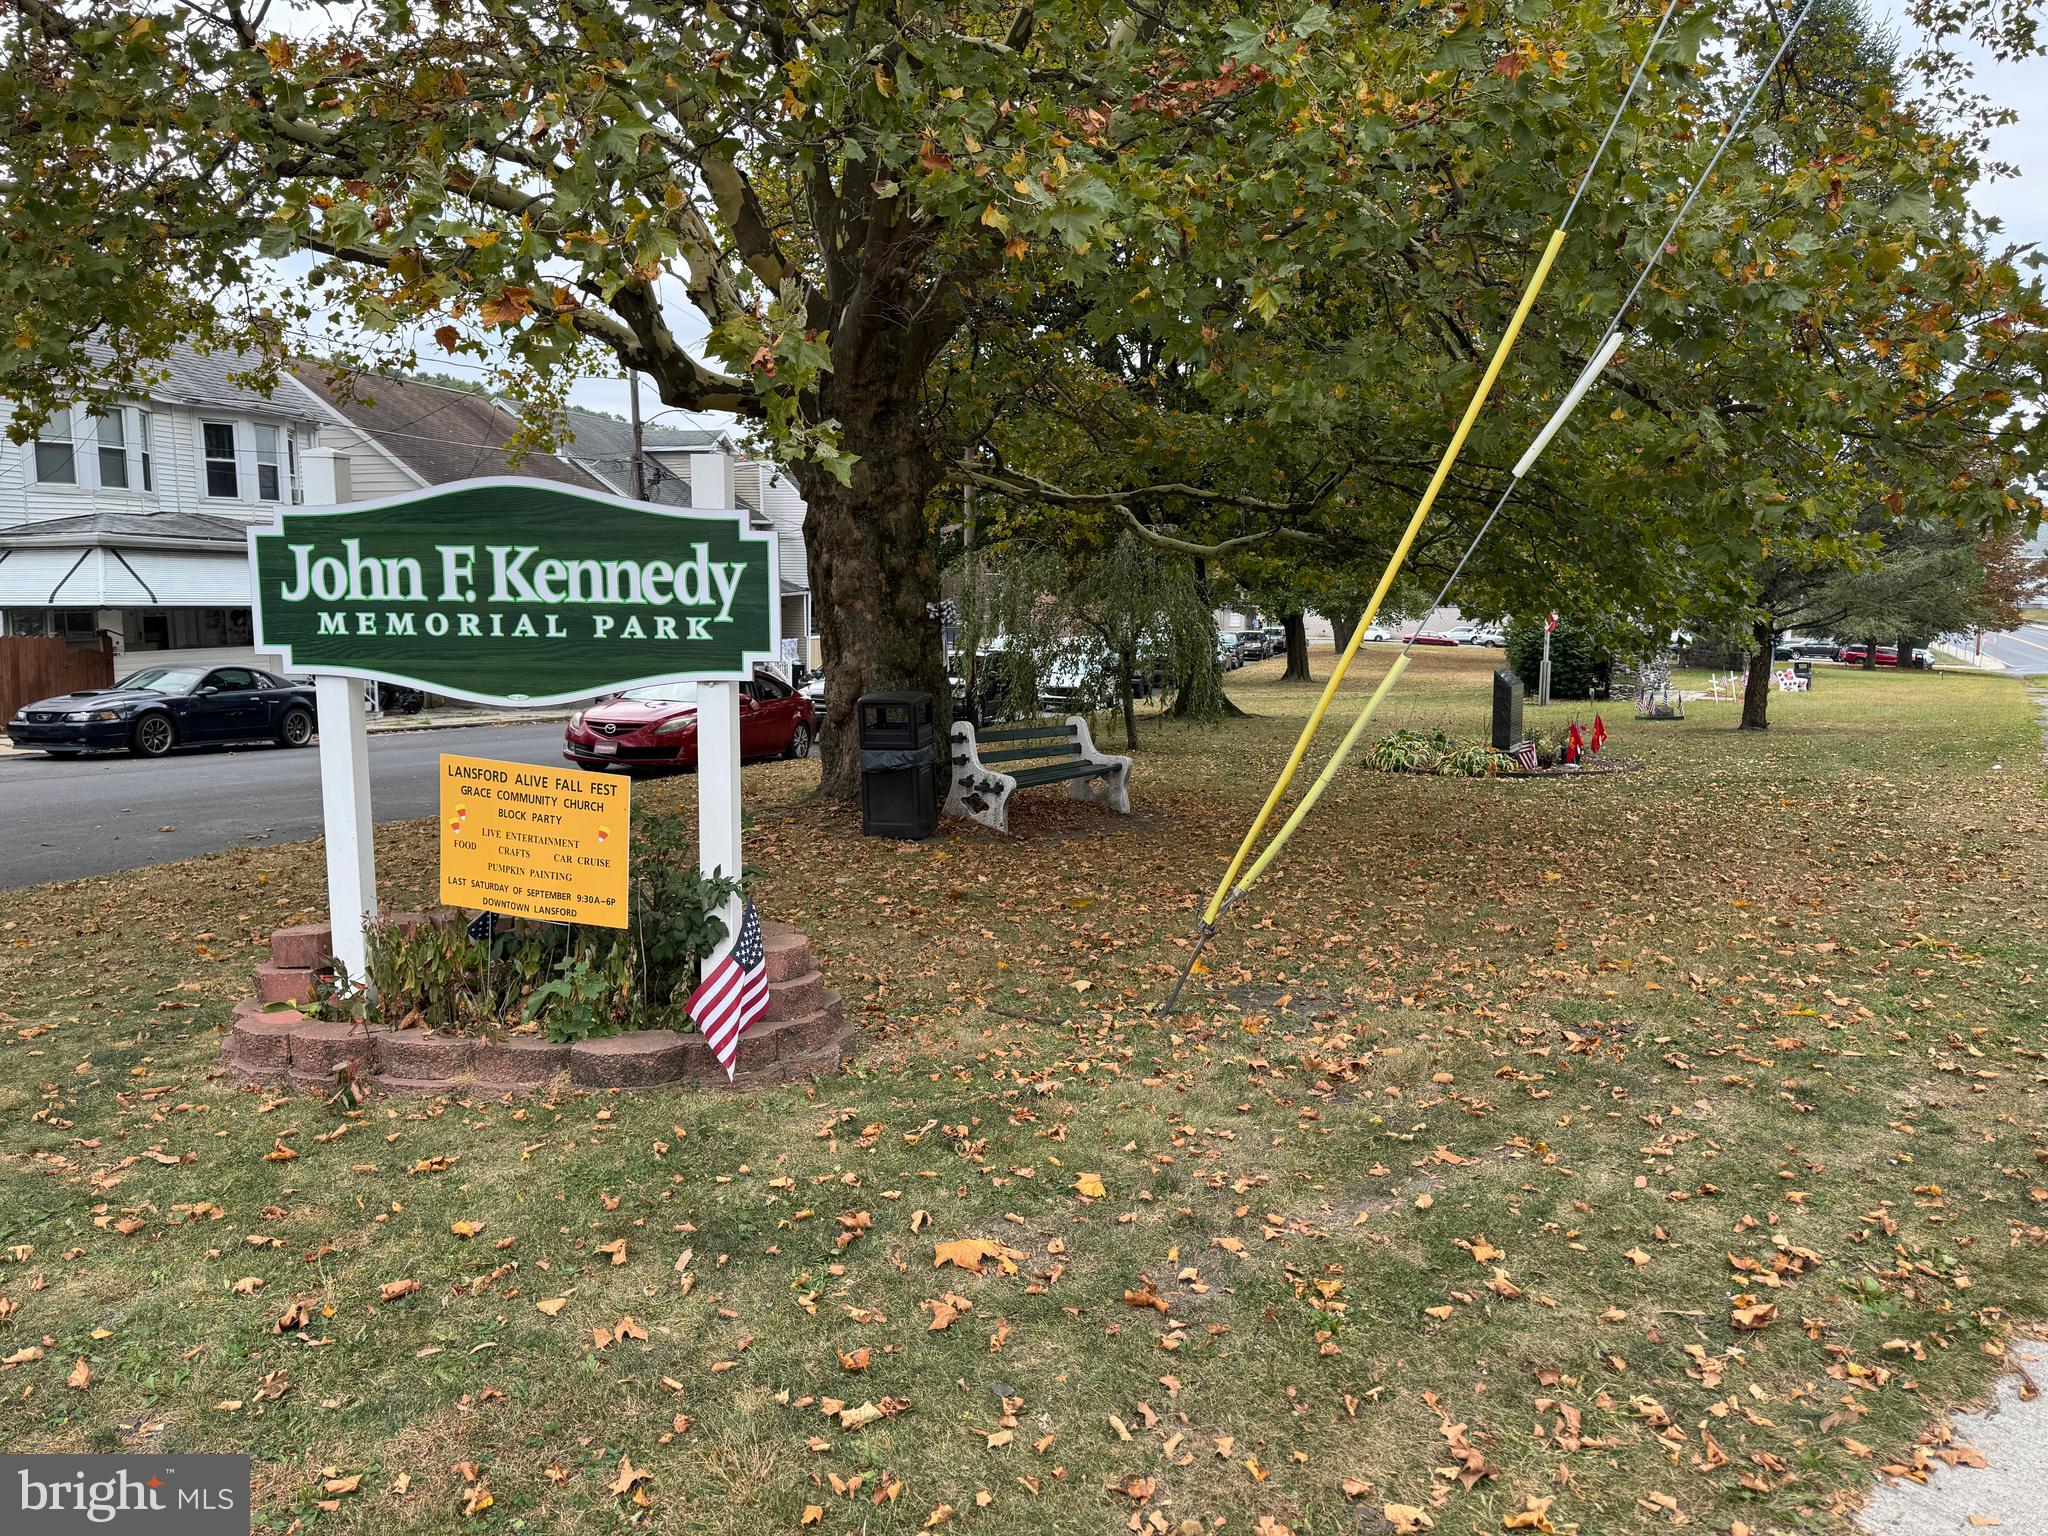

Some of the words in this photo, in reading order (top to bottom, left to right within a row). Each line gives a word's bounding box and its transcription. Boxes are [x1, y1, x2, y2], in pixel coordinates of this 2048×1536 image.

[281, 538, 428, 602] John
[435, 545, 476, 603] F.
[486, 541, 748, 623] Kennedy
[316, 611, 568, 638] MEMORIAL
[592, 615, 714, 640] PARK
[448, 765, 508, 783] LANSFORD
[515, 773, 548, 788] ALIVE
[555, 778, 583, 792] FALL
[590, 783, 617, 796] FEST
[461, 785, 491, 798] GRACE
[497, 790, 558, 806] COMMUNITY
[563, 799, 604, 812] CHURCH
[498, 809, 526, 820] BLOCK
[532, 813, 562, 824] PARTY
[482, 828, 501, 838] LIVE
[506, 832, 580, 849] ENTERTAINMENT
[454, 840, 477, 850] FOOD
[498, 846, 530, 858] CRAFTS
[554, 854, 573, 864] CAR
[577, 857, 610, 868] CRUISE
[488, 863, 525, 875] PUMPKIN
[530, 869, 572, 881] PAINTING
[448, 877, 466, 886] LAST
[471, 879, 509, 892] SATURDAY
[513, 887, 523, 895] OF
[527, 888, 571, 900] SEPTEMBER
[577, 894, 616, 905] 9:30A-6P
[483, 898, 530, 912] DOWNTOWN
[534, 906, 577, 917] LANSFORD
